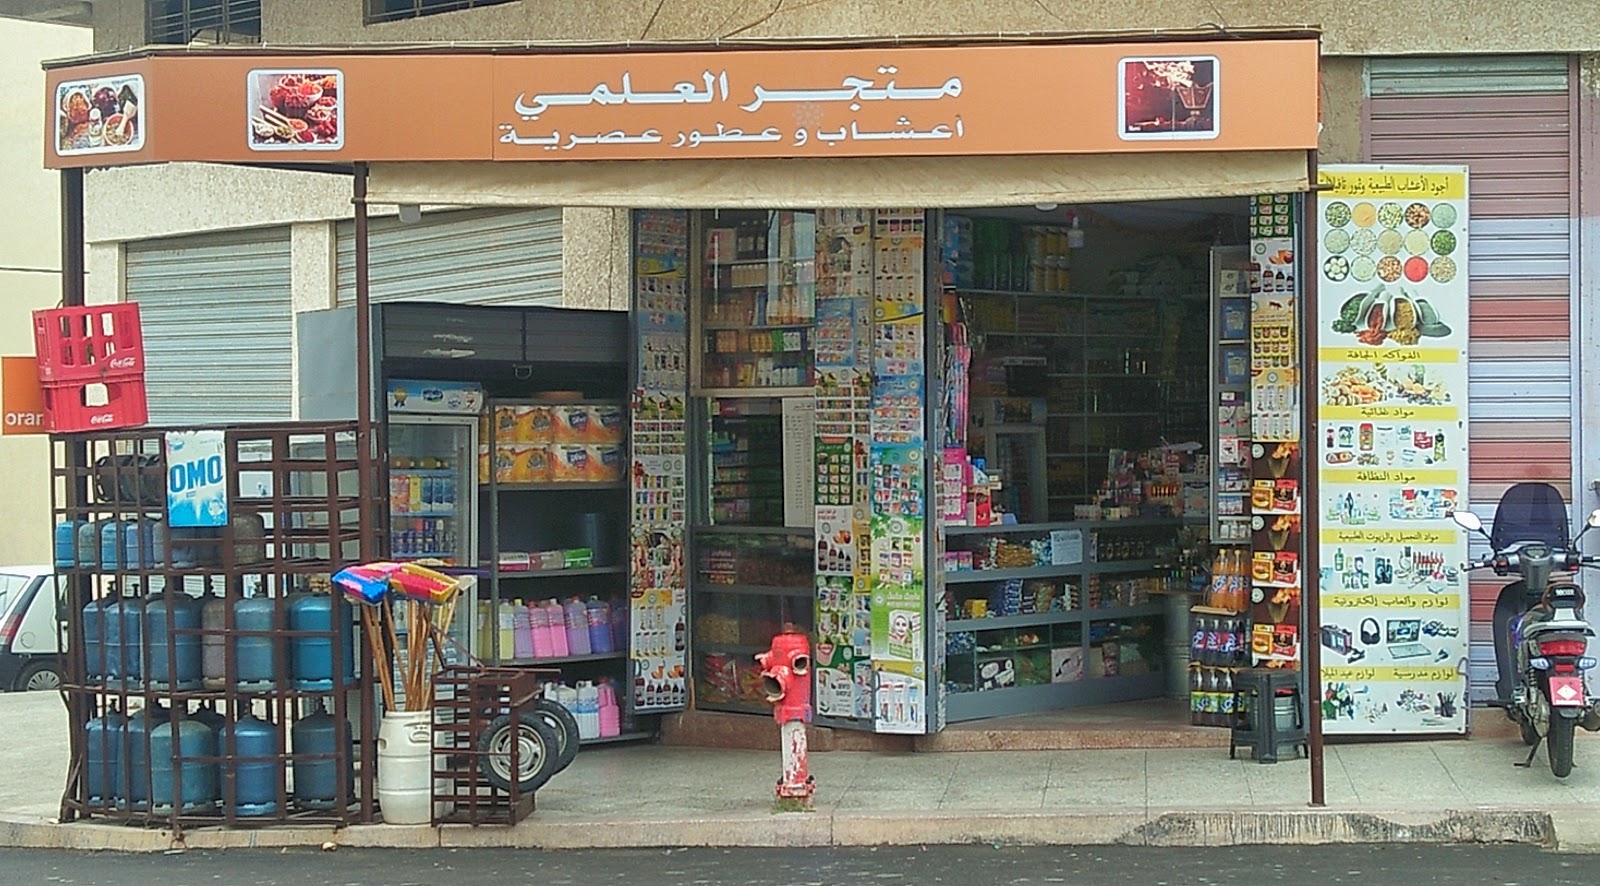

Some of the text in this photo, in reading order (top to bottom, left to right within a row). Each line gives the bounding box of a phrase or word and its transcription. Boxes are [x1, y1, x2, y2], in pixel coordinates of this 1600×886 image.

[514, 65, 963, 121] متجر العلمي
[499, 115, 964, 151] أعشاب و عطور عصرية
[1397, 175, 1429, 194] الأعشاب
[1431, 176, 1449, 196] أجود
[1347, 349, 1421, 361] الفواكه الجافة
[1393, 407, 1415, 419] مواد
[169, 455, 224, 493] OMO
[1357, 470, 1416, 484] مواد النظافة
[1424, 531, 1439, 543] مواد
[1421, 596, 1449, 609] لوازم
[1356, 667, 1375, 681] لوازم
[1393, 667, 1454, 681] لوازم مدرسية
